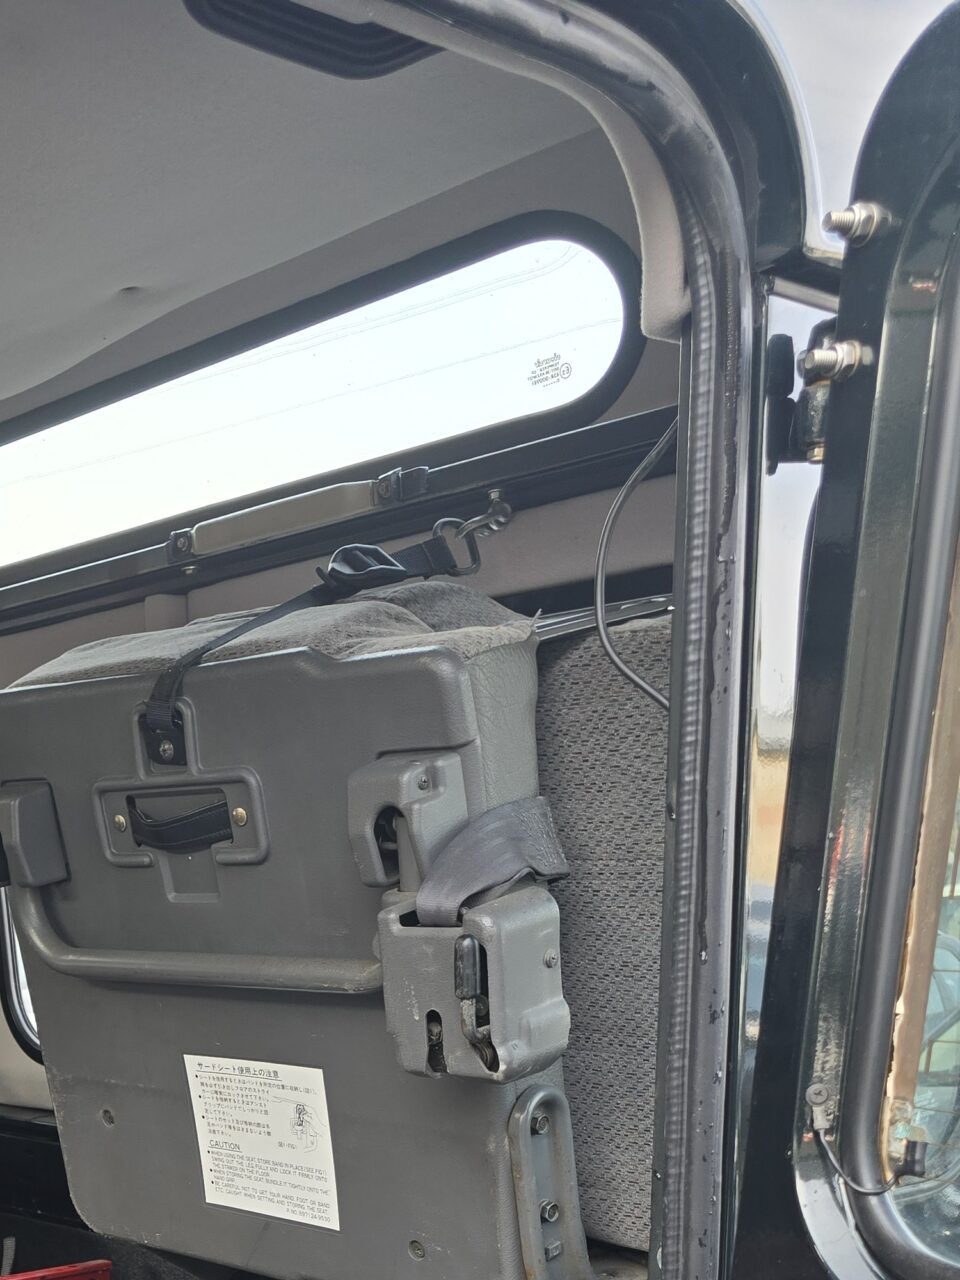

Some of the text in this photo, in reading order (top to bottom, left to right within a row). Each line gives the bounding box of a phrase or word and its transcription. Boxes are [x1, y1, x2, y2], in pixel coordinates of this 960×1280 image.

[197, 1062, 279, 1077] サードシート使用上の注意
[209, 1139, 240, 1150] CAUTION
